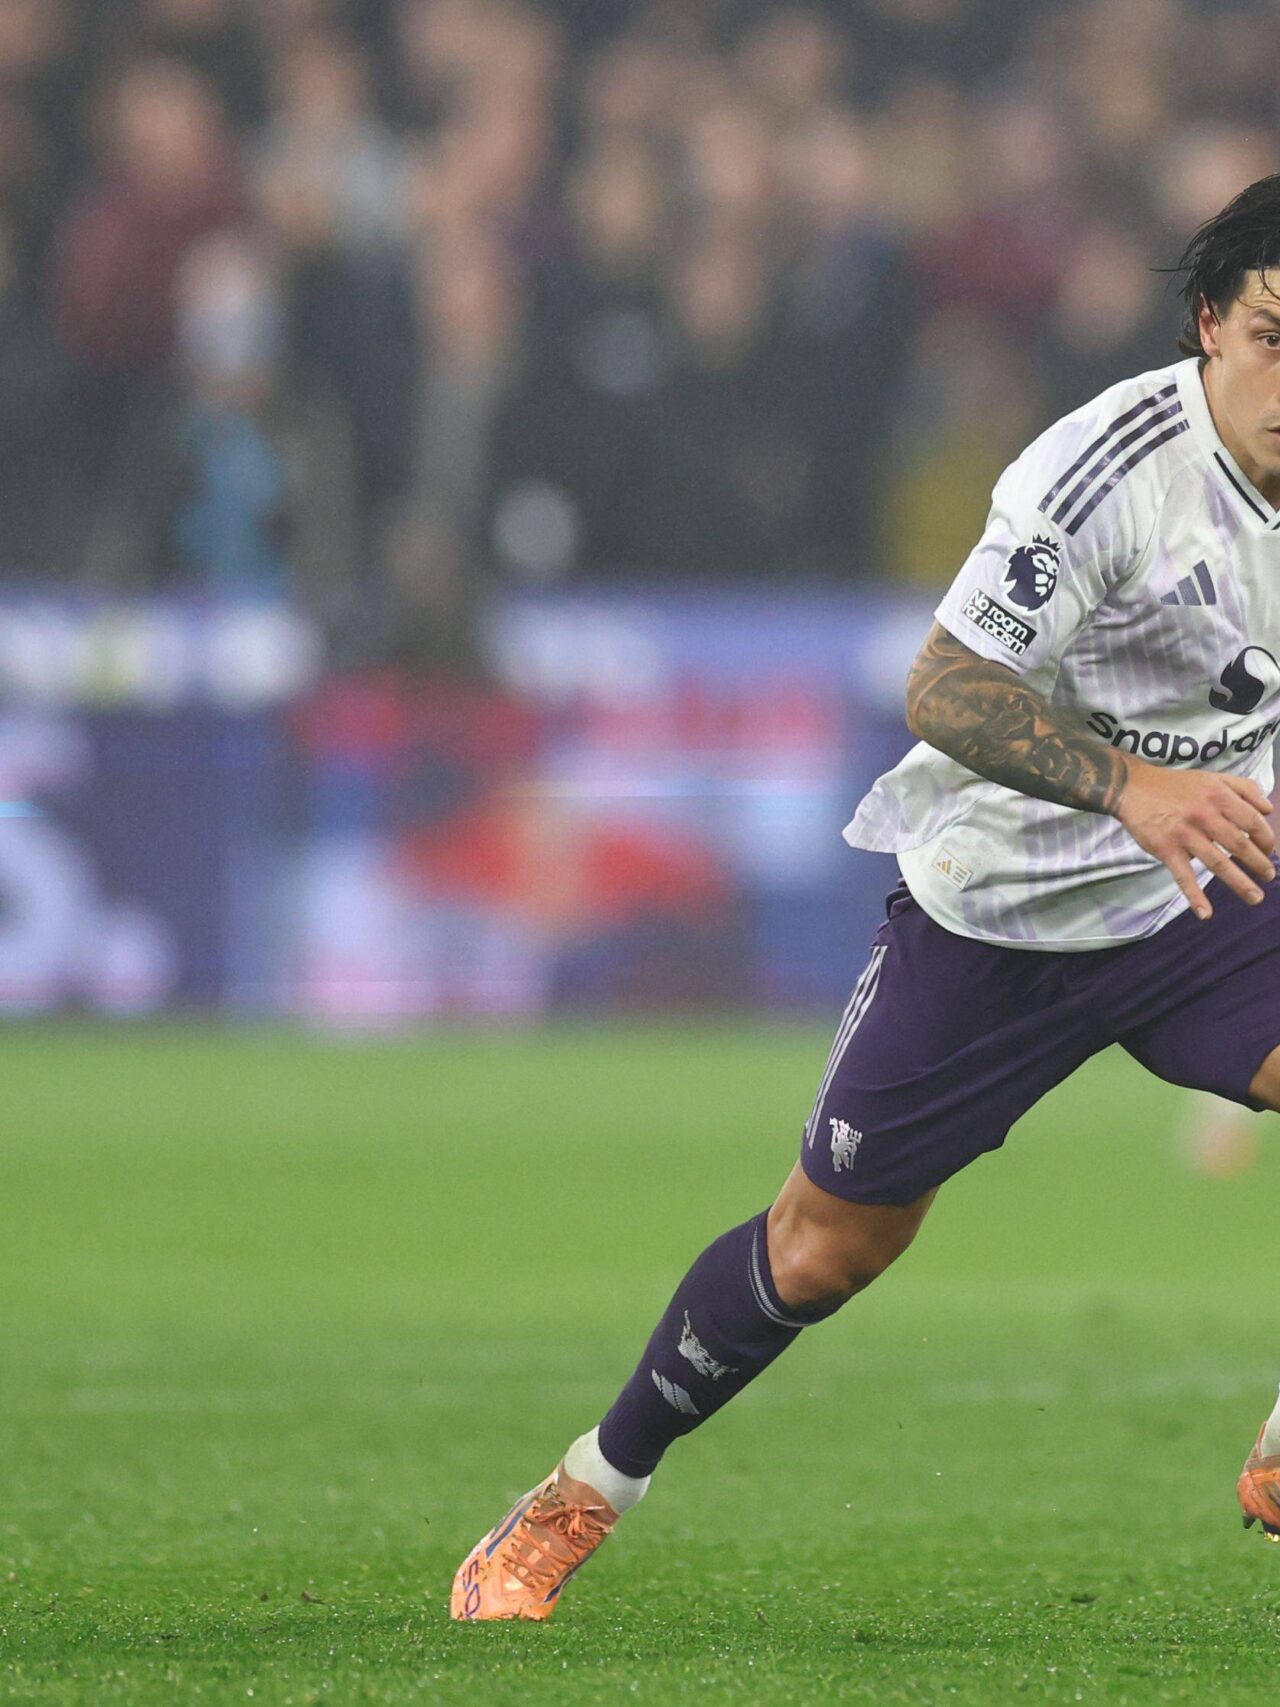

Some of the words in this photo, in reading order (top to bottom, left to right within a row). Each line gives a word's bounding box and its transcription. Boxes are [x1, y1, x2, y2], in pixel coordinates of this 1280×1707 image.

[962, 603, 983, 620] for
[979, 616, 1027, 655] racism
[968, 589, 990, 611] No
[987, 606, 1028, 640] room
